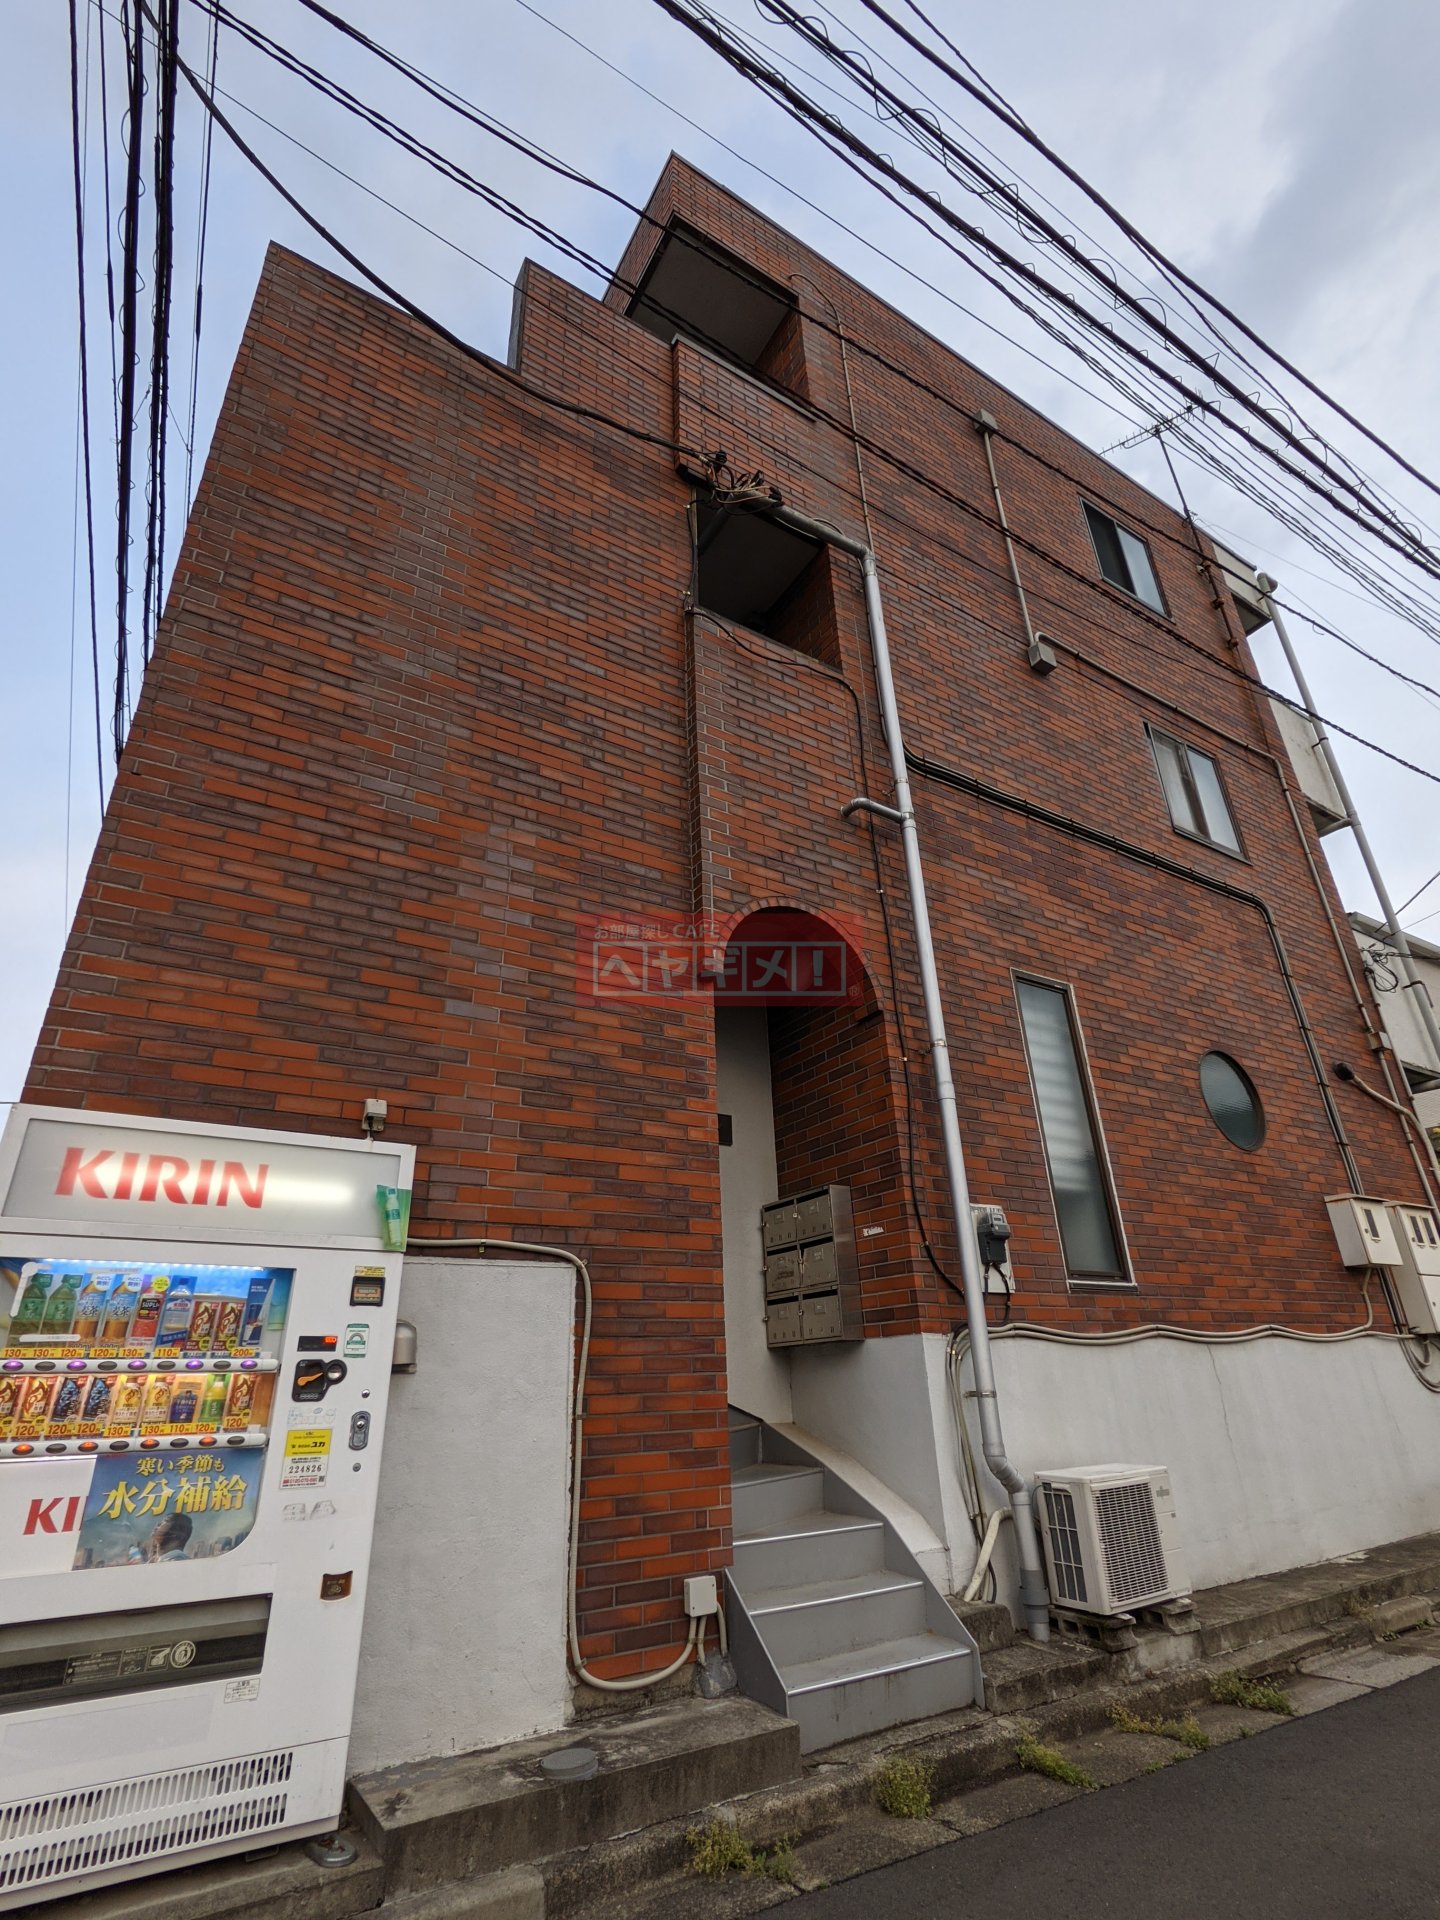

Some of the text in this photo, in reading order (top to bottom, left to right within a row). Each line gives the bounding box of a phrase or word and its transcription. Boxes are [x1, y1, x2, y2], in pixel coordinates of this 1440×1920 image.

[55, 1146, 269, 1209] KIRIN
[135, 1454, 226, 1476] 寒い季節も
[288, 1464, 322, 1475] 224826
[97, 1474, 249, 1519] 水分補給
